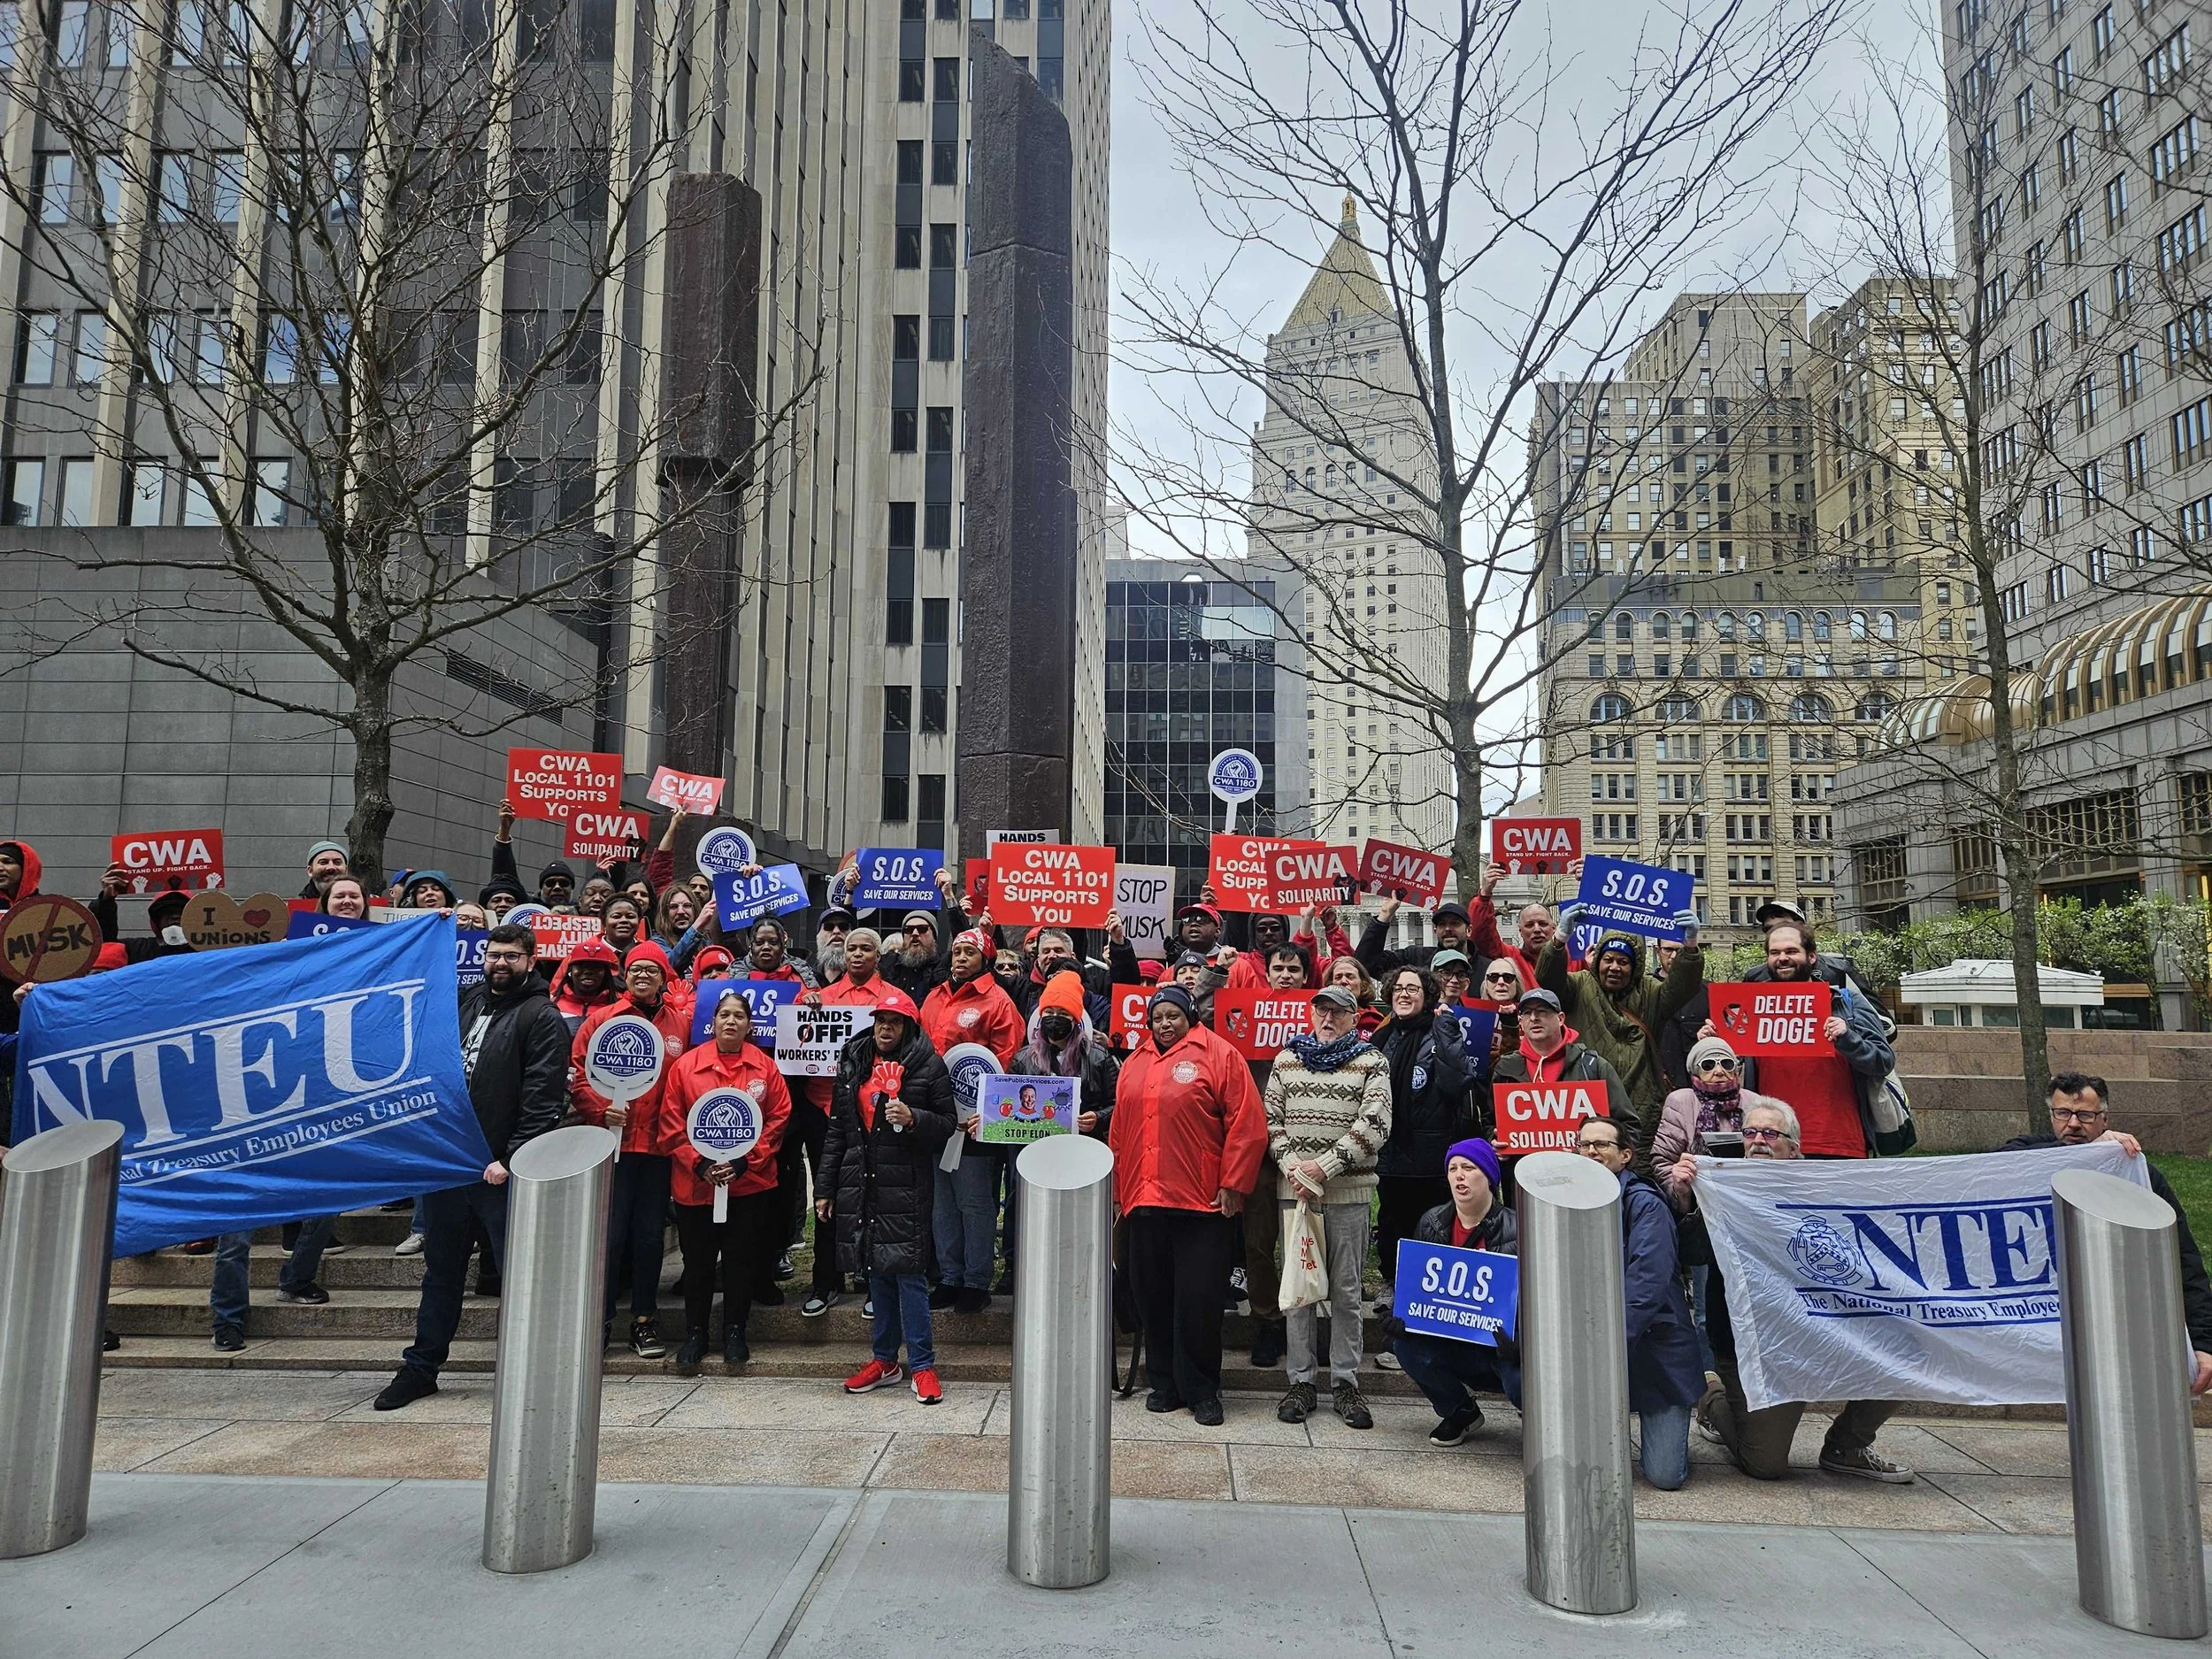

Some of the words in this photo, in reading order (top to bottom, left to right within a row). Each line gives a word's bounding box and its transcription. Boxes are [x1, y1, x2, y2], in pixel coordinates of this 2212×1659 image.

[539, 754, 591, 772] CWA
[573, 772, 615, 788] 1101
[660, 774, 713, 799] CWA
[1214, 777, 1234, 786] CWA
[545, 802, 582, 817] YO
[575, 812, 640, 839] CWA
[999, 833, 1046, 842] HANDS
[1503, 827, 1572, 851] CWA
[123, 838, 212, 868] CWA
[572, 842, 640, 858] SOLIDARITY
[1025, 849, 1081, 870] CWA
[703, 855, 725, 866] CWA
[872, 856, 926, 882] S.O.S.
[1275, 852, 1347, 881] CWA
[1371, 849, 1437, 887] CWA
[733, 871, 787, 903] S.O.S.
[1062, 871, 1108, 888] 1101
[1222, 872, 1268, 889] SUPP
[1371, 872, 1386, 880] STAND
[1399, 878, 1415, 887] FIGHT
[1601, 869, 1669, 908] S.O.S.
[863, 889, 884, 900] SAVE
[883, 890, 898, 900] OUR
[898, 890, 933, 901] SERVICES
[1118, 878, 1167, 904] STOP
[1278, 887, 1350, 905] SOLIDARITY
[729, 910, 749, 922] SAVE
[749, 904, 764, 917] OUR
[764, 893, 799, 912] SERVICES
[1247, 893, 1270, 909] YO
[203, 907, 216, 926] I
[533, 916, 602, 931] RESPECT
[1031, 905, 1071, 924] YOU
[1587, 903, 1611, 918] SAVE
[1613, 909, 1632, 923] OUR
[1632, 911, 1677, 931] SERVICES
[7, 922, 94, 962] MUSK
[1608, 941, 1627, 949] UFT
[1254, 1000, 1307, 1019] DELETE
[1754, 995, 1816, 1014] DELETE
[797, 1010, 853, 1023] HANDS
[797, 1024, 853, 1043] OFF!
[1255, 1022, 1309, 1048] DOGE
[1756, 1017, 1818, 1044] DOGE
[595, 1054, 624, 1065] CWA
[626, 1056, 653, 1067] 1180
[777, 1048, 830, 1061] WORKERS'
[27, 986, 425, 1148] NTEU
[994, 1076, 1065, 1086] SavePublicServices.com
[1507, 1088, 1597, 1121] CWA
[149, 1146, 241, 1174] Treasury
[244, 1111, 365, 1156] Employees
[367, 1090, 437, 1122] Union
[695, 1128, 723, 1138] CWA
[726, 1128, 752, 1138] 1180
[1005, 1128, 1027, 1138] STOP
[1029, 1130, 1051, 1139] ELON
[1509, 1131, 1578, 1148] SOLIDAR
[1842, 1203, 2059, 1291] NTE
[1422, 1256, 1494, 1303] S.O.S.
[1408, 1302, 1436, 1319] SAVE
[1436, 1307, 1458, 1324] OUR
[1458, 1311, 1503, 1333] SERVICES
[1799, 1293, 1828, 1310] The
[1832, 1293, 1911, 1318] National
[1916, 1302, 1988, 1326] Treasury
[1989, 1301, 2060, 1326] Employe
